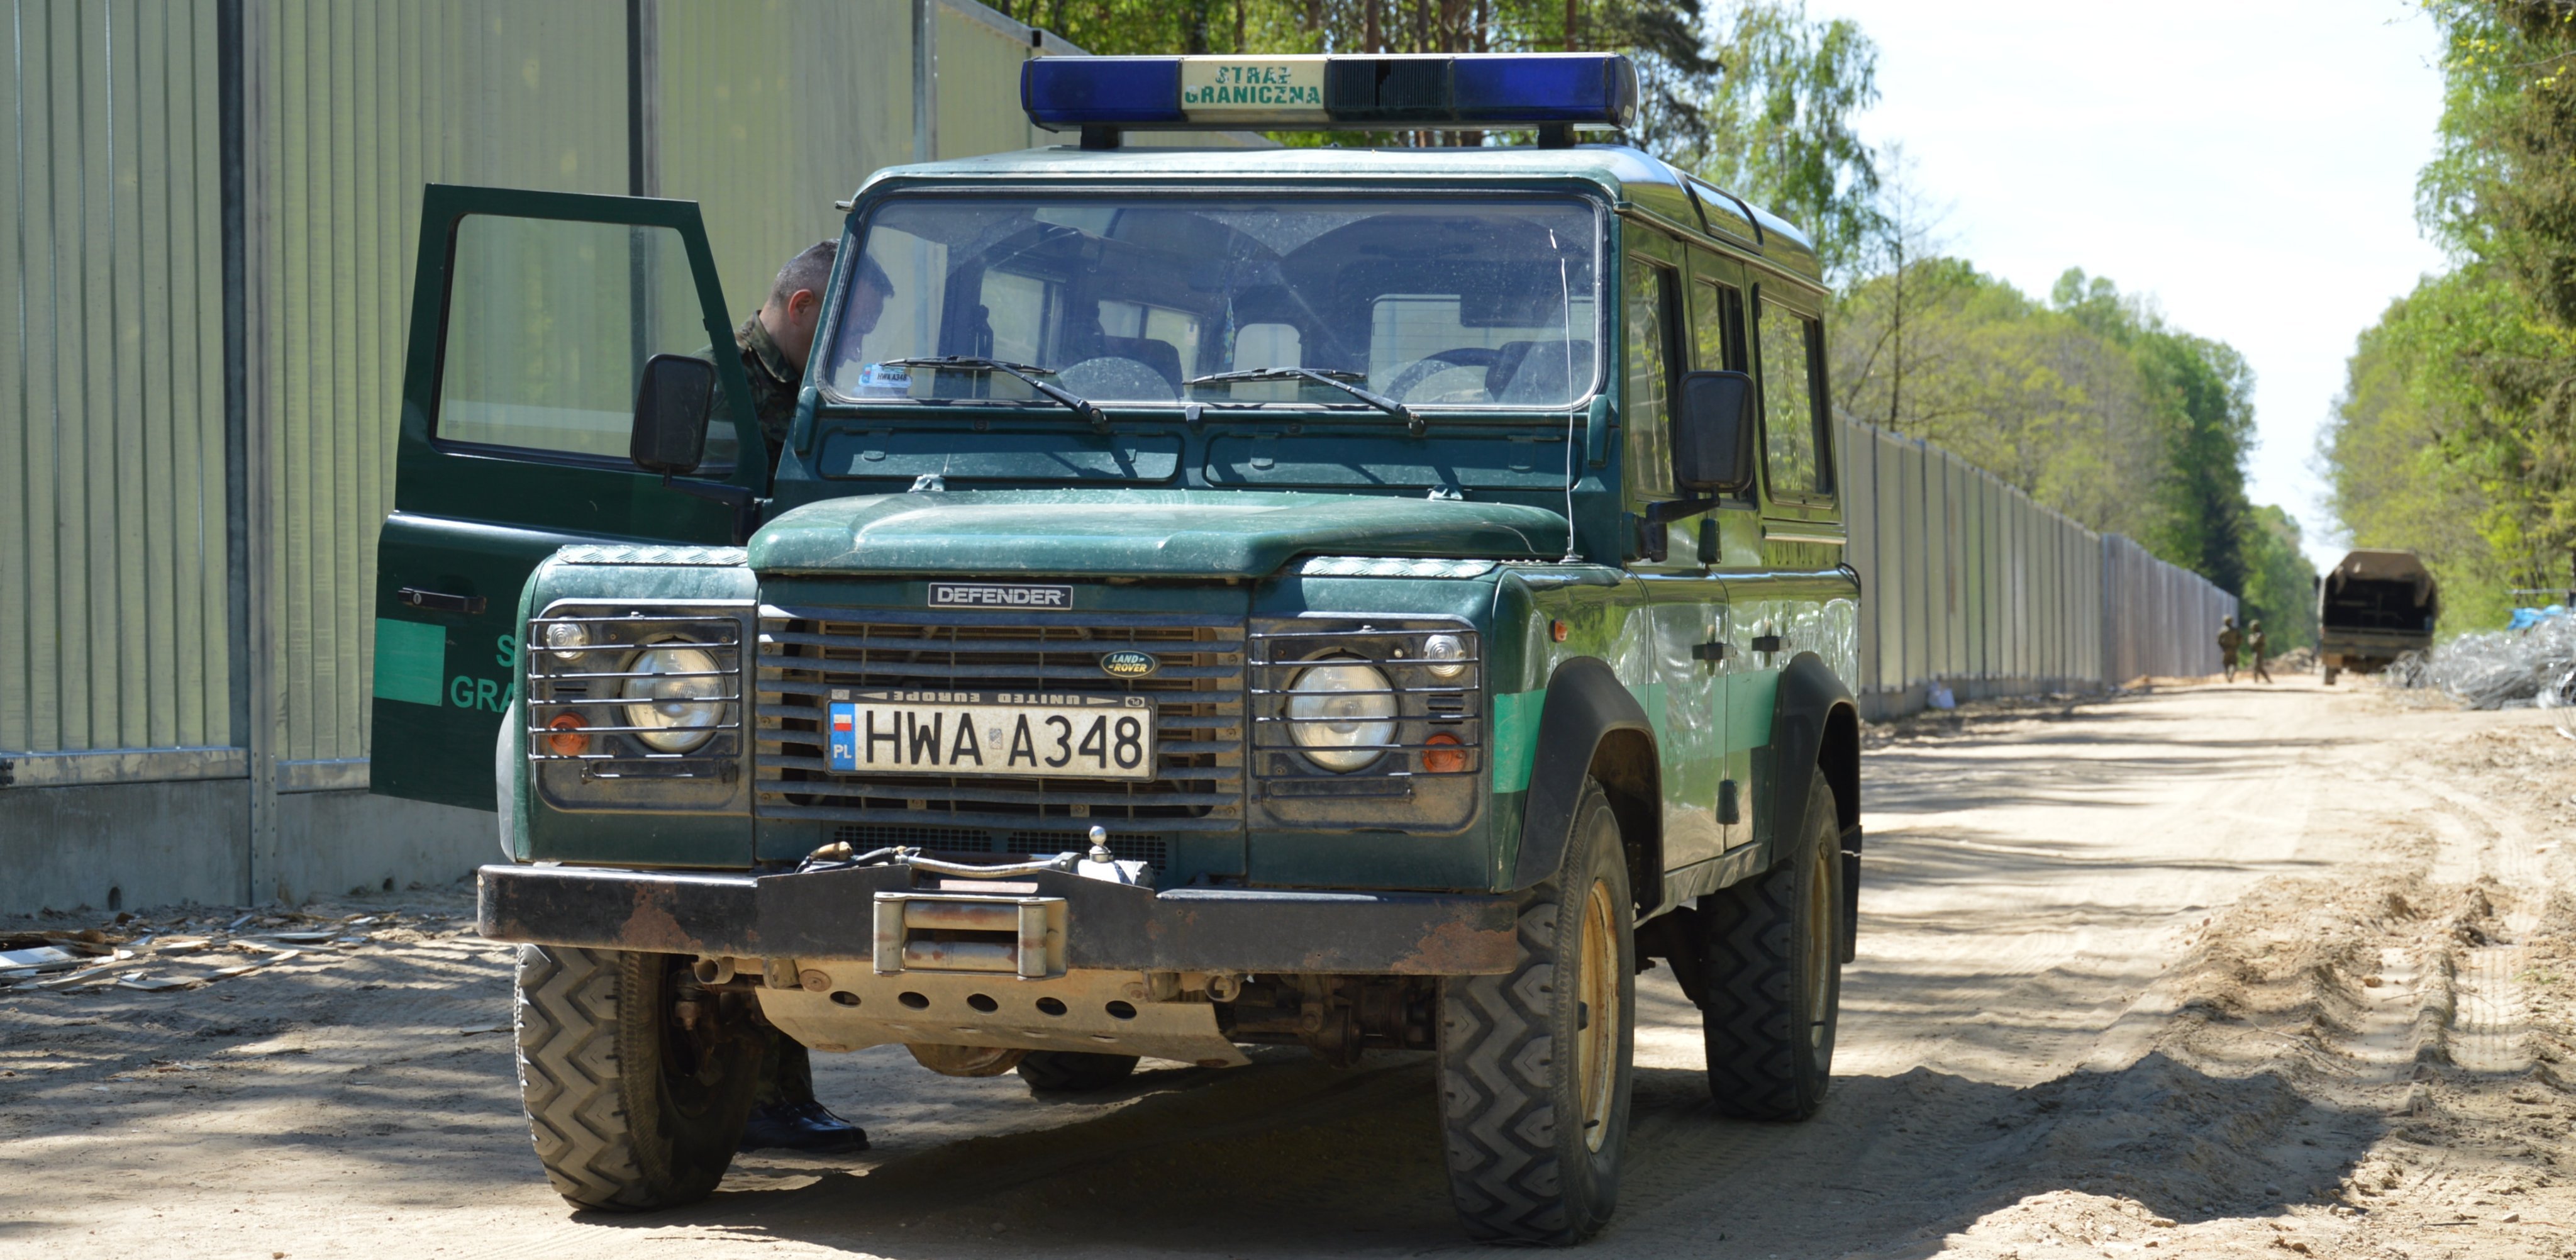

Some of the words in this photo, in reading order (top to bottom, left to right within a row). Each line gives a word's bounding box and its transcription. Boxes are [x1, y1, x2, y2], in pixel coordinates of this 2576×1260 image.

[1185, 85, 1321, 104] GRANICZNA
[937, 587, 1061, 605] DEFENDER
[1111, 654, 1139, 663] LAND
[1114, 663, 1147, 672] ROVER
[893, 691, 980, 703] EUROPE
[997, 693, 1080, 705] UNITED
[866, 710, 984, 766] HWA
[1008, 713, 1142, 769] A348
[833, 745, 852, 759] PL
